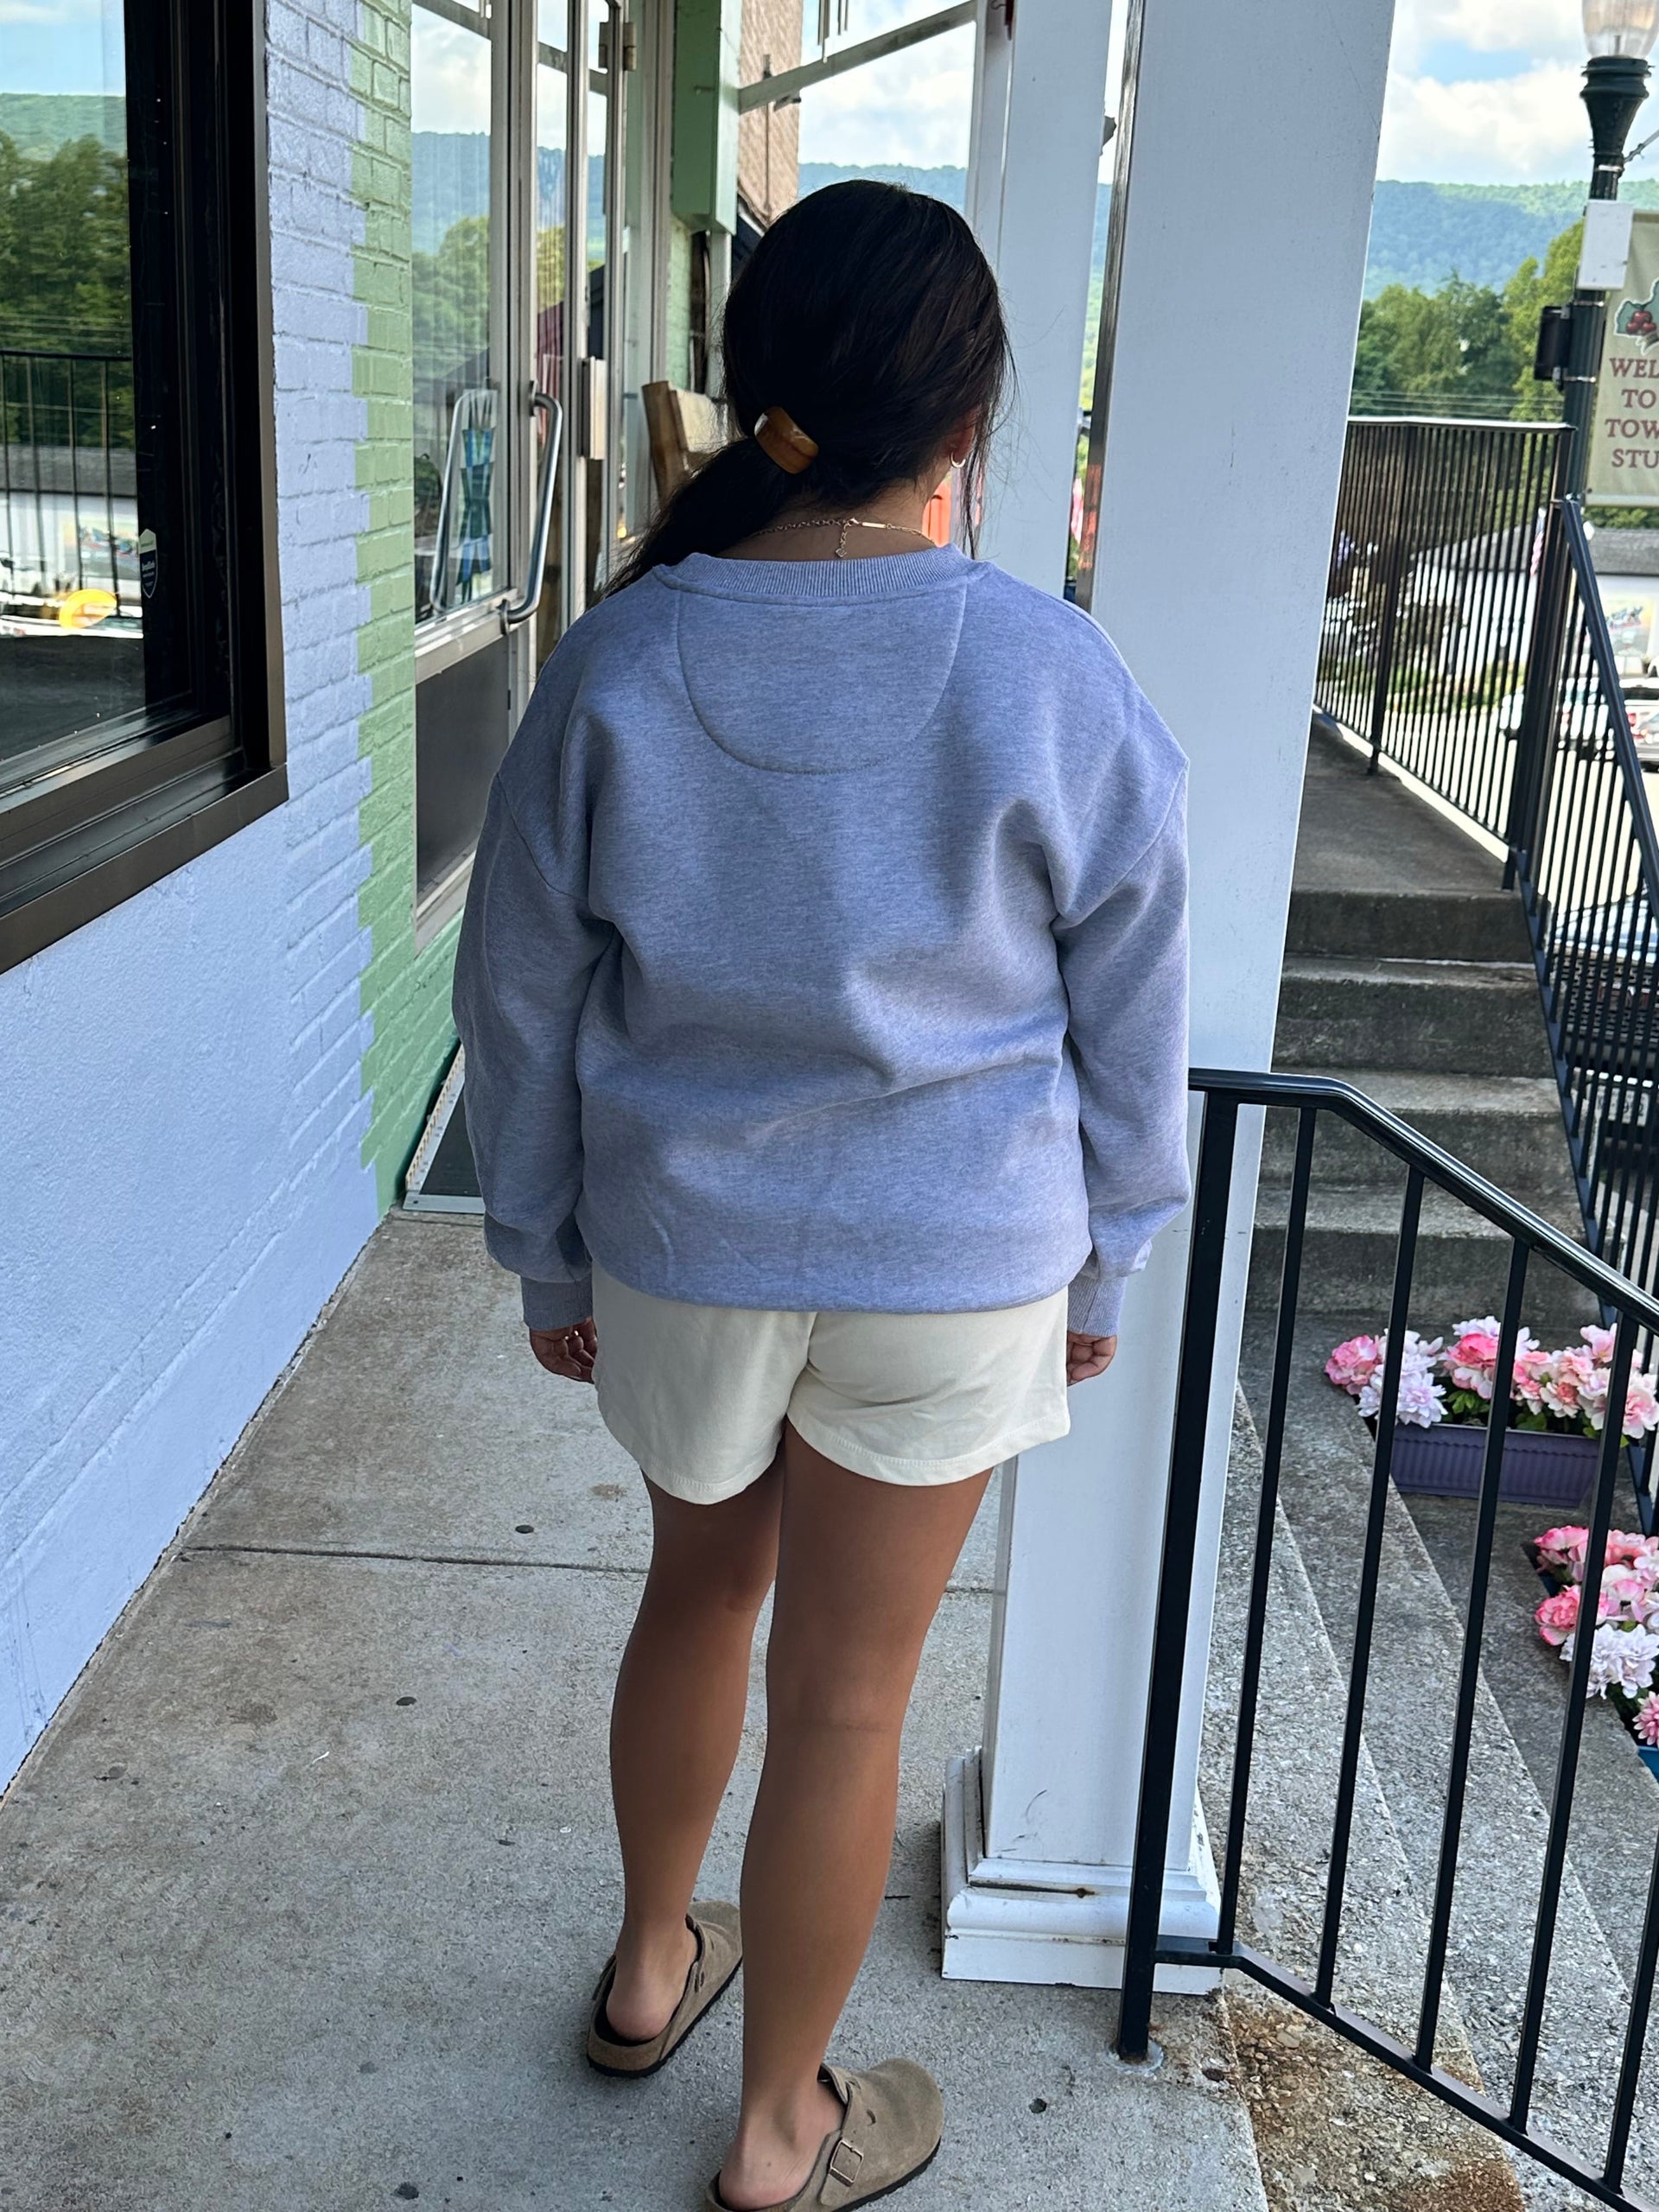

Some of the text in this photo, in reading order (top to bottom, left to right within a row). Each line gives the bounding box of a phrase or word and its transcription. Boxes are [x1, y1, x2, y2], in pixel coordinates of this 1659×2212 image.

[1609, 358, 1659, 378] WEL
[1621, 389, 1656, 409] TO
[1605, 418, 1659, 439] TOW
[1611, 448, 1659, 469] STU
